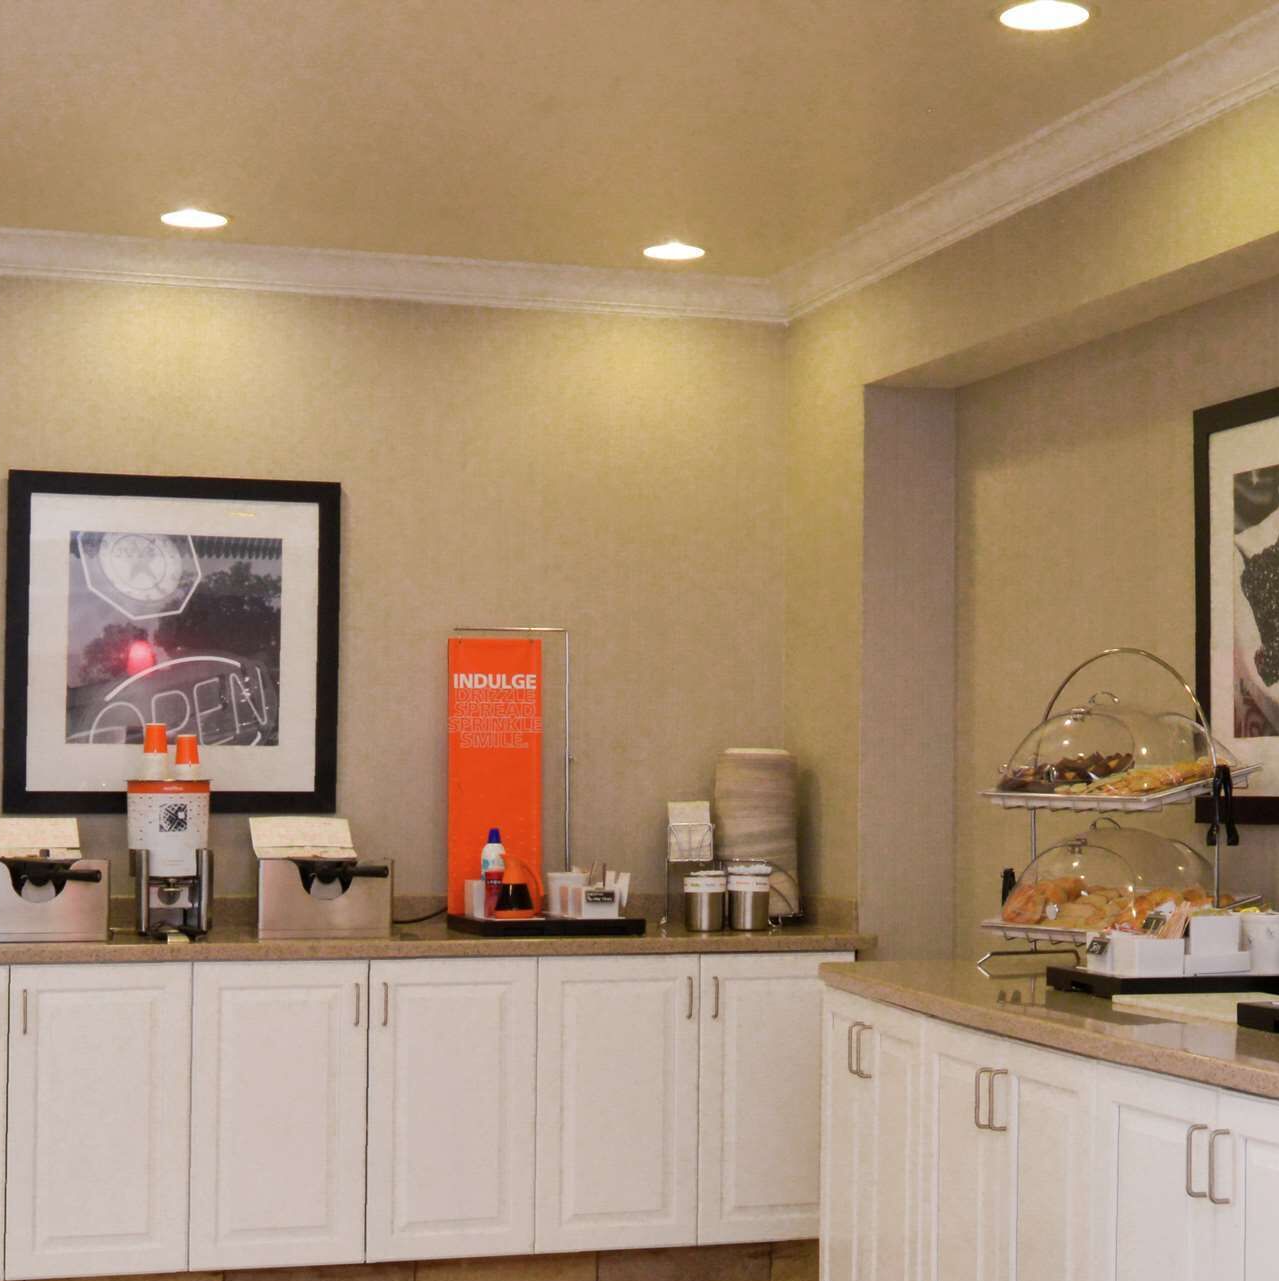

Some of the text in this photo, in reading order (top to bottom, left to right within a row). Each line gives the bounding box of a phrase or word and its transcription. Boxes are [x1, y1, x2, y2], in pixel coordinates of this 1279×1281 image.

[453, 673, 537, 689] INDULGE
[456, 688, 536, 704] DRIZZLE
[455, 701, 537, 719] SPREAD
[447, 716, 544, 734] SPRINKLE
